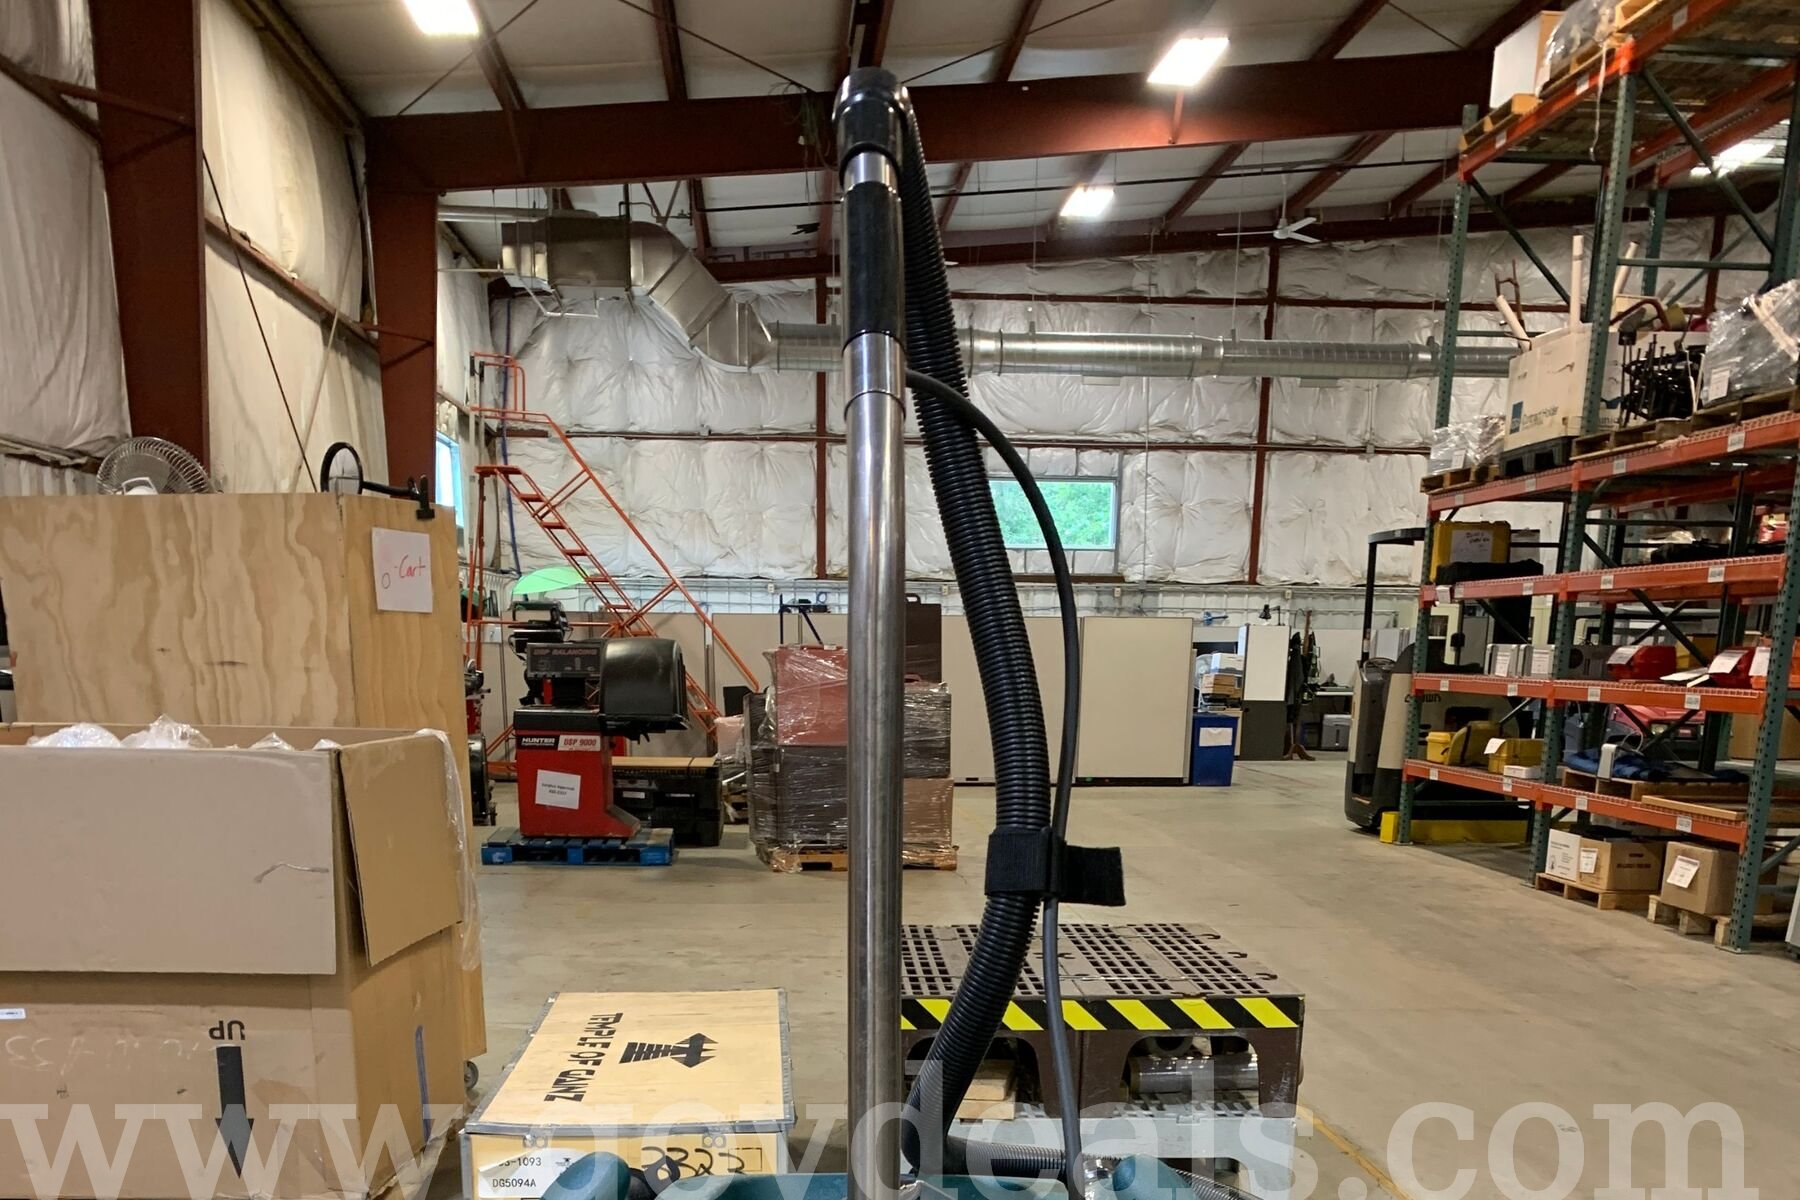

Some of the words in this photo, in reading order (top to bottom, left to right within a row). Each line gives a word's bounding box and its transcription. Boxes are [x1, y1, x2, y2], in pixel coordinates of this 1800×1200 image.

[579, 738, 597, 746] 9000
[208, 1019, 246, 1041] UP
[576, 1012, 624, 1049] TEMPLE
[567, 1051, 606, 1067] OF
[543, 1069, 596, 1102] GAINZ
[492, 1178, 537, 1188] DG5094A
